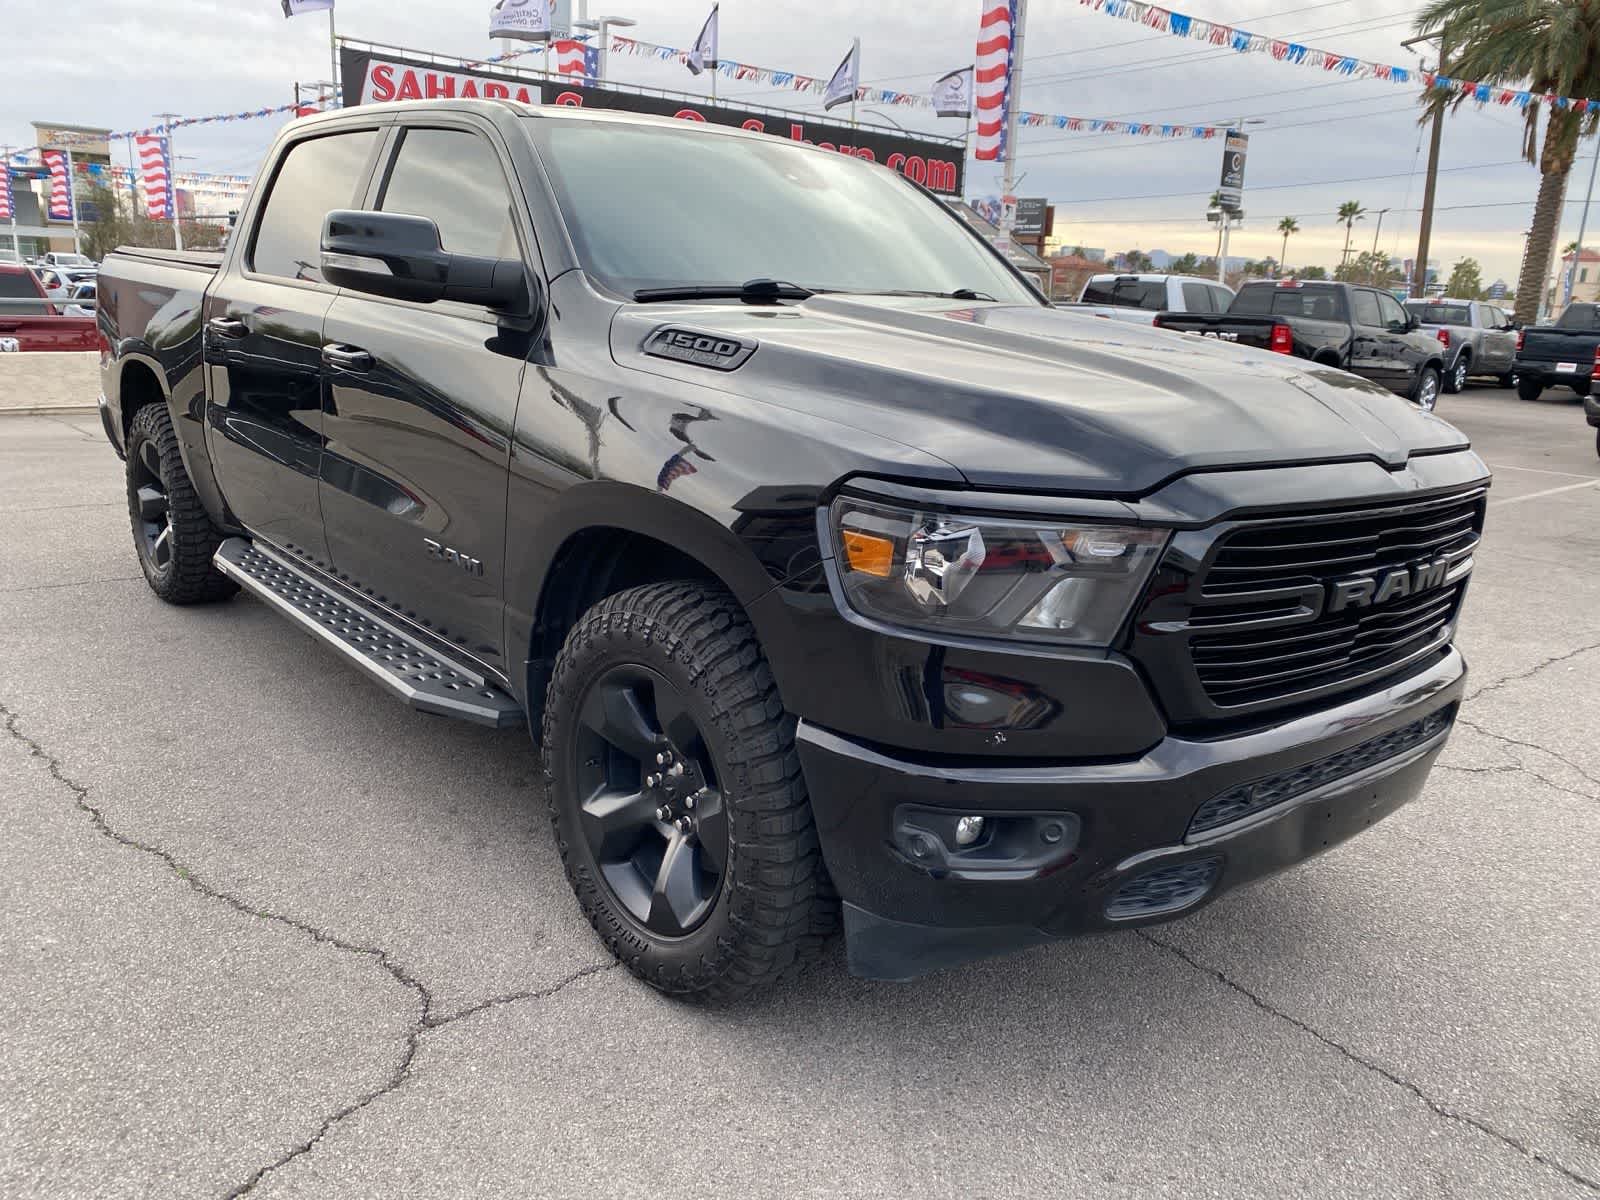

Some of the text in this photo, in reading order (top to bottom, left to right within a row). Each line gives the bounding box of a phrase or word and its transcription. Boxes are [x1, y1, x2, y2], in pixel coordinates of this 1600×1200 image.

[371, 64, 532, 105] SAHARA
[665, 331, 738, 356] 1500
[1327, 558, 1447, 613] RAM
